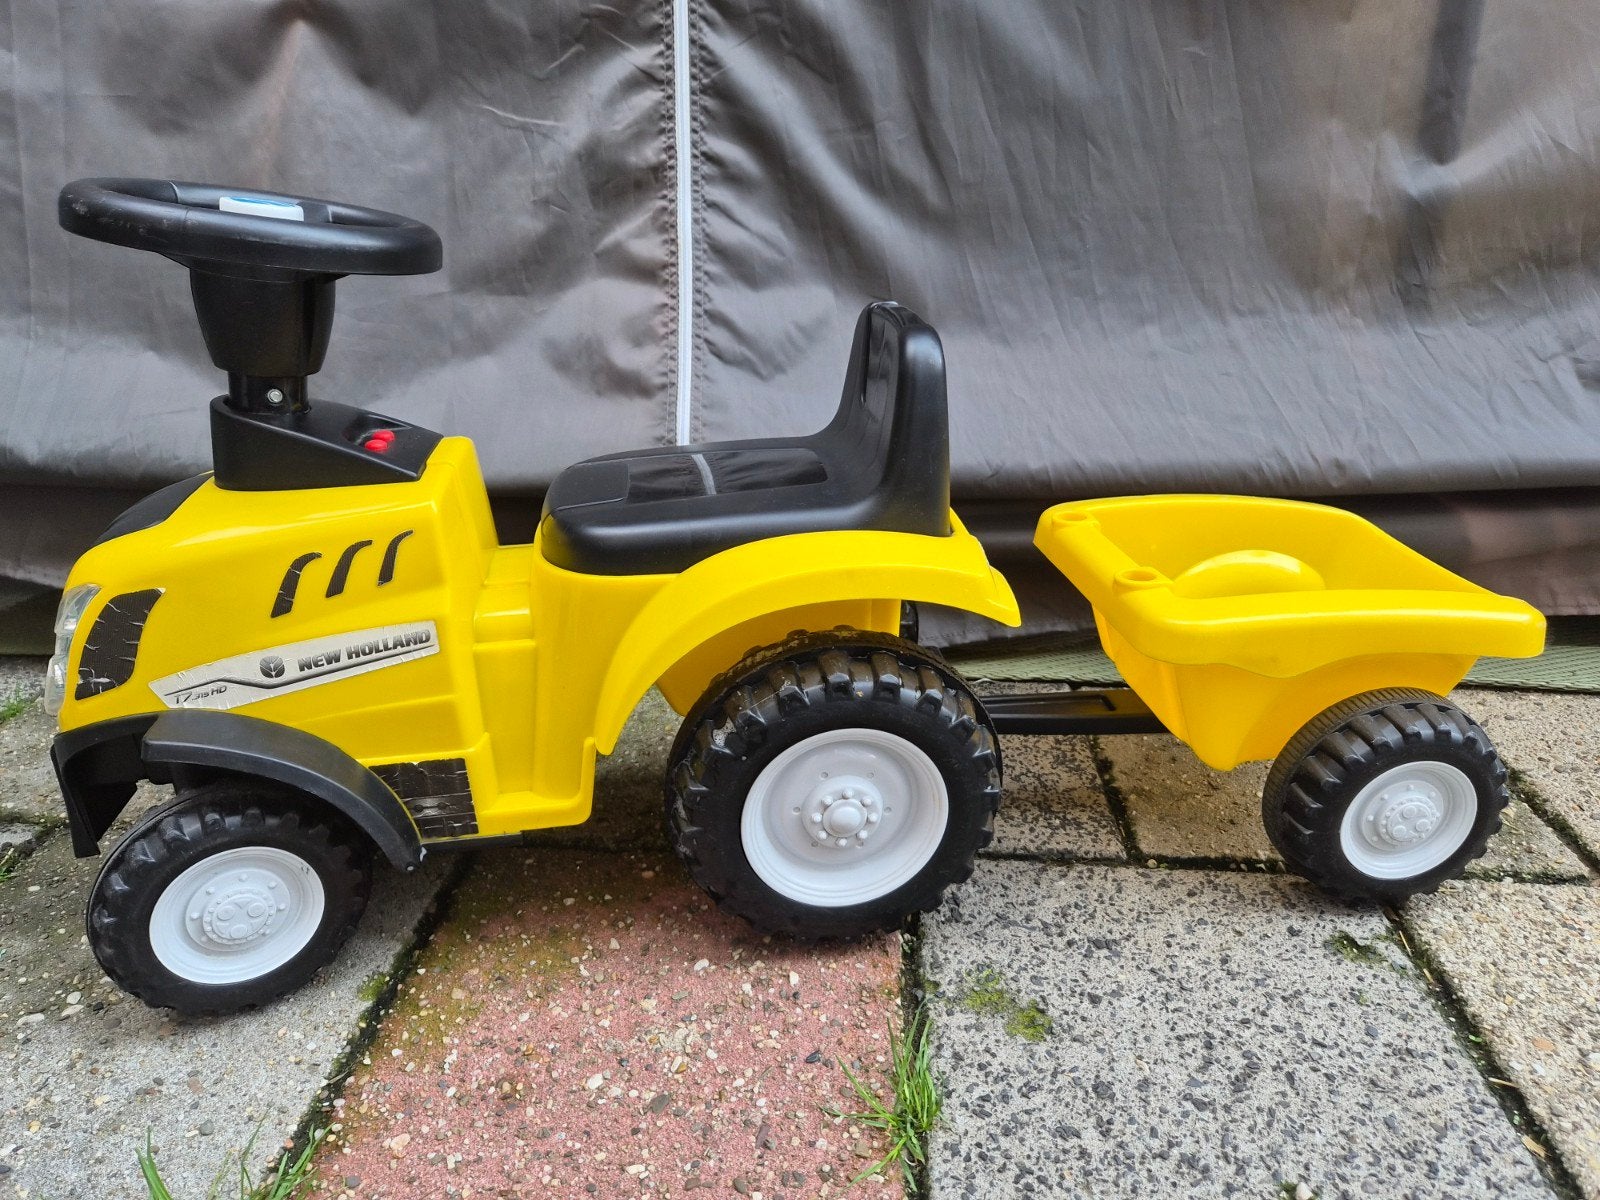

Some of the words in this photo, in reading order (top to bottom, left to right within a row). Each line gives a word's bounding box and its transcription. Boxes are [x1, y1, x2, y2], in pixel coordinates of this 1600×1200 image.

[298, 649, 341, 672] NEW
[345, 629, 431, 660] HOLLAND
[211, 685, 227, 696] HD
